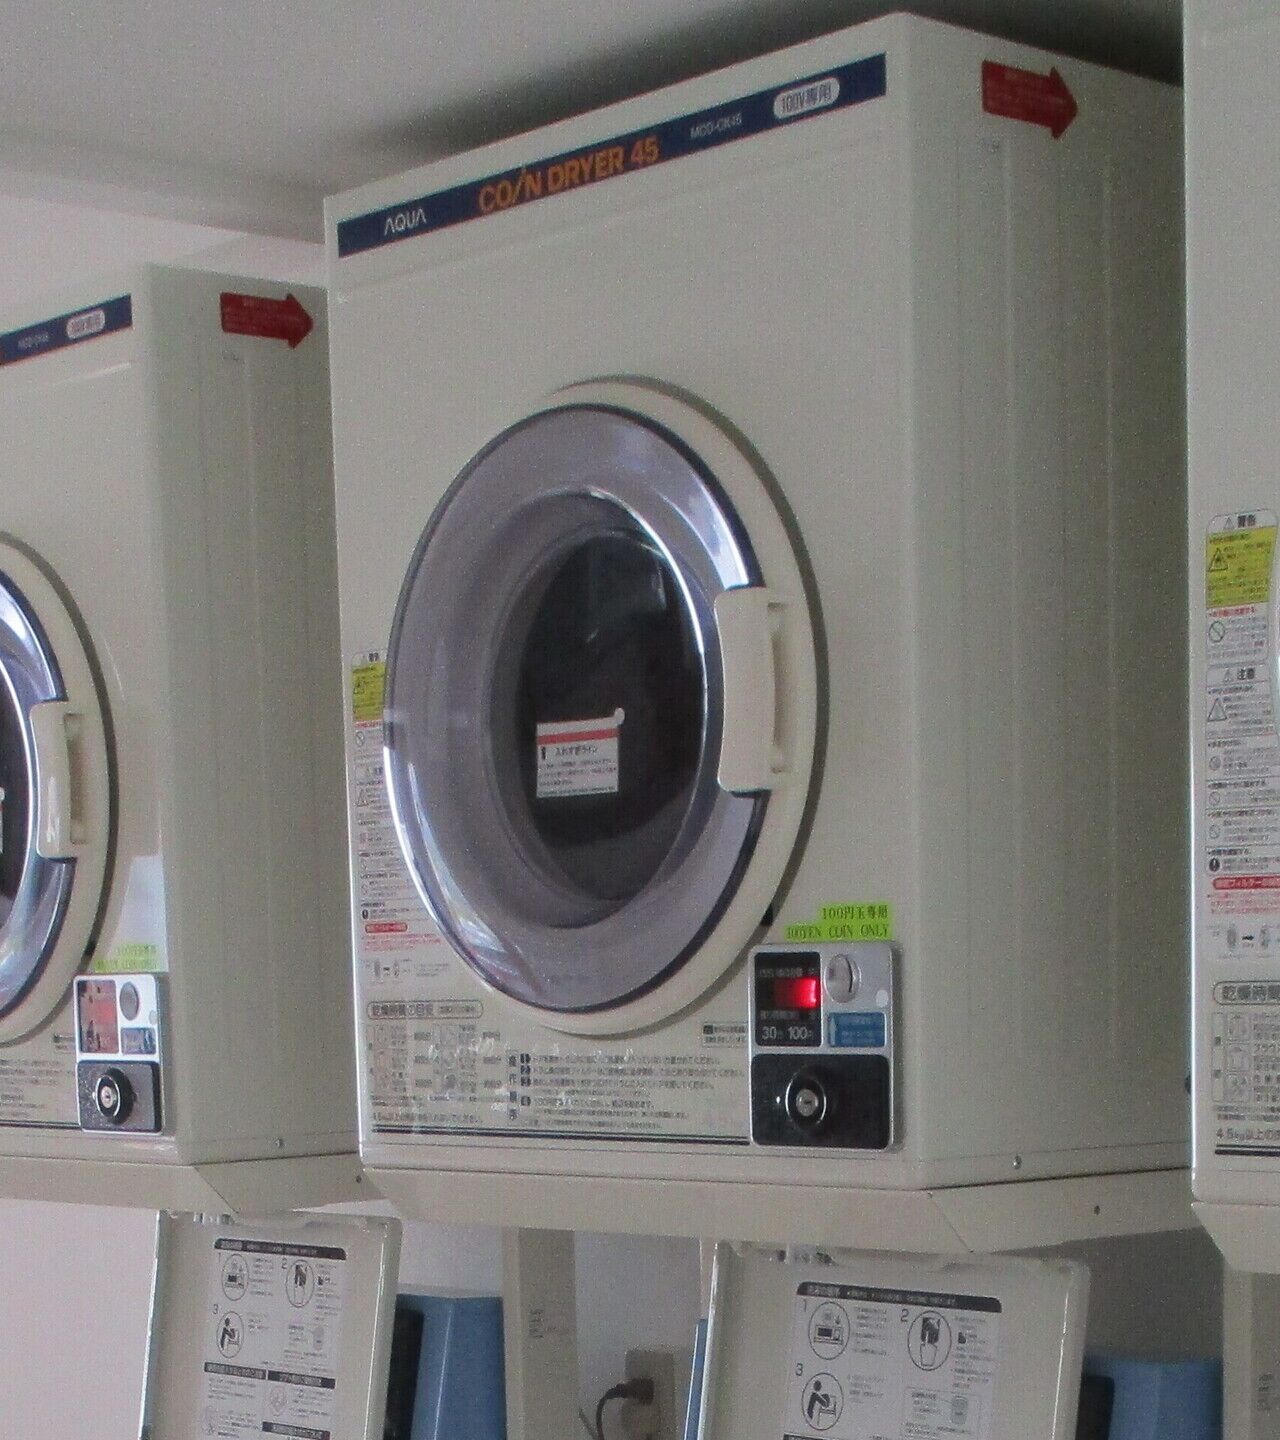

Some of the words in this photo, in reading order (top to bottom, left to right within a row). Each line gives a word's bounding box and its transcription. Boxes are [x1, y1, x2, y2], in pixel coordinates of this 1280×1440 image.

[547, 146, 625, 192] DRYER
[630, 134, 661, 164] 45
[383, 208, 428, 236] AQUA
[828, 924, 854, 939] COIN
[900, 1308, 910, 1323] 2
[795, 1362, 804, 1377] 3
